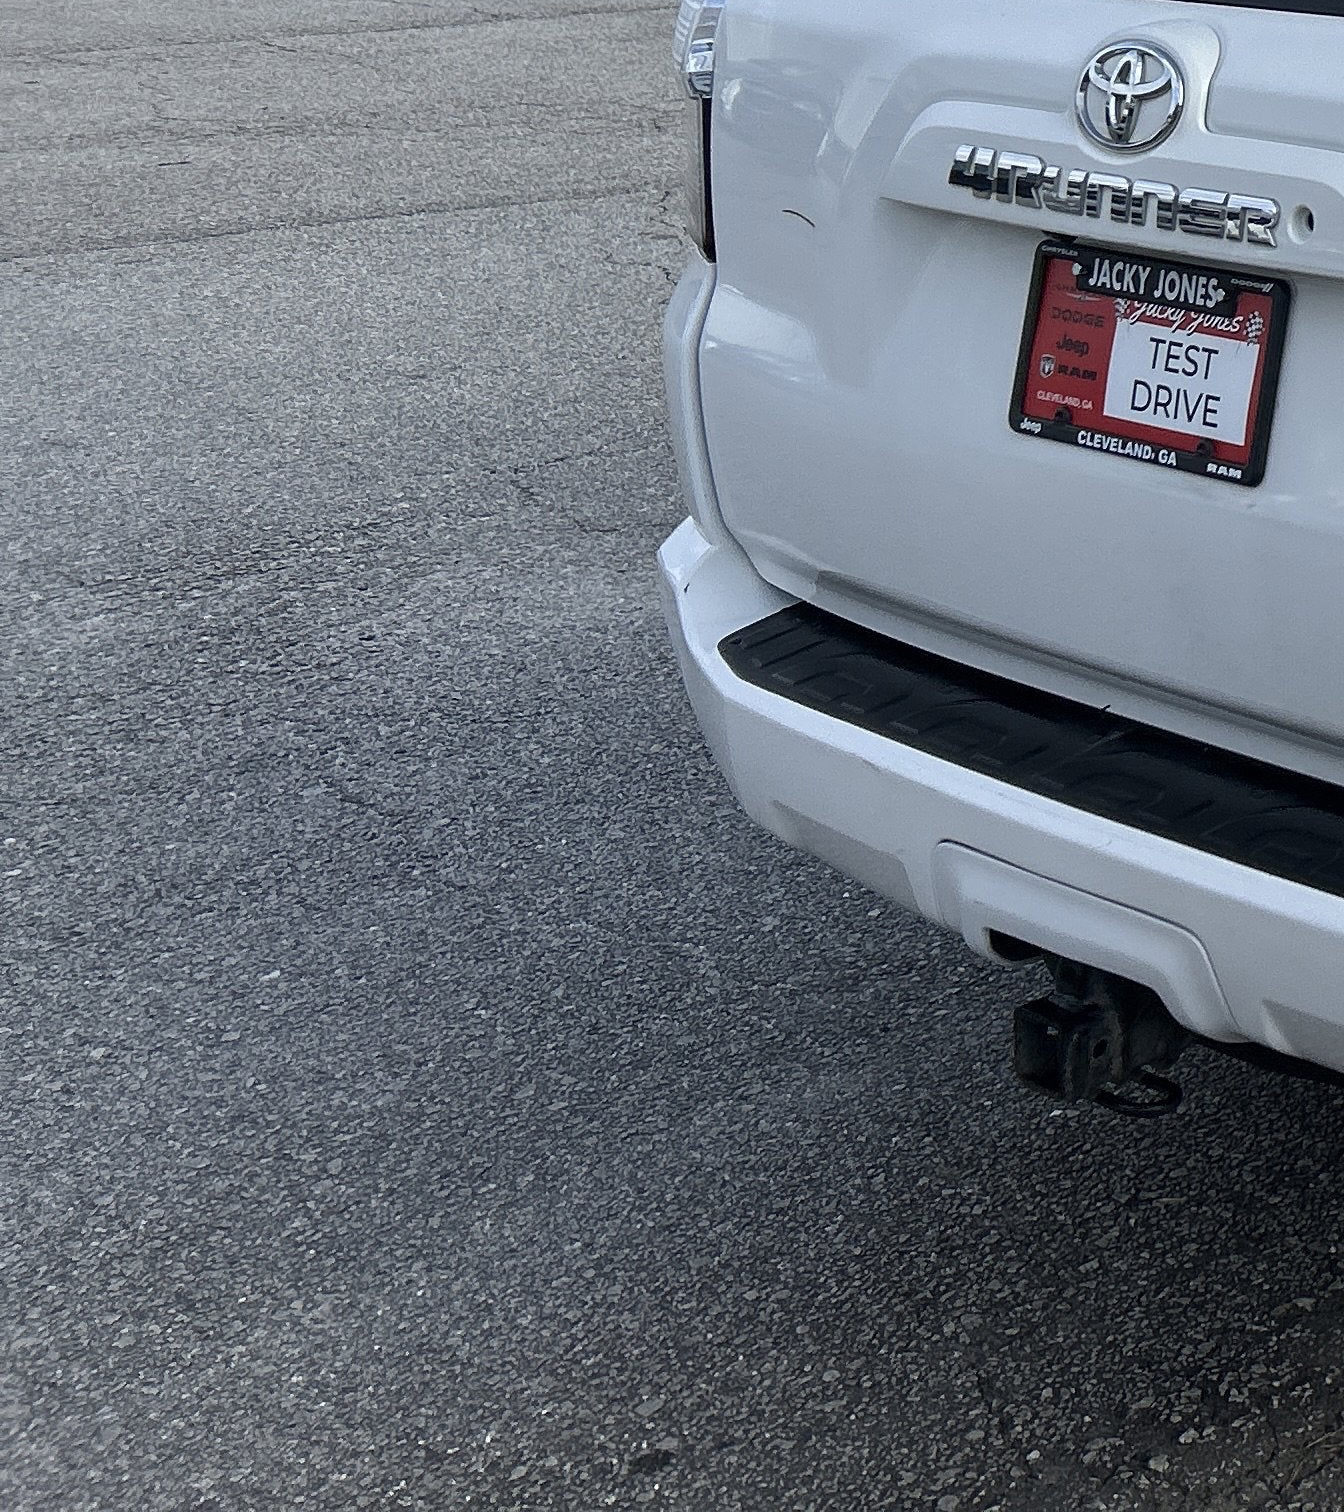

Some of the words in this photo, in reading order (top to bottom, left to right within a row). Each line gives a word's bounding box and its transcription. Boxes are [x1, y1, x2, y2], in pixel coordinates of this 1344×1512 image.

[949, 144, 1282, 248] 4RUNNER
[1088, 258, 1151, 295] JACKY
[1153, 272, 1219, 309] JONES
[1051, 306, 1105, 328] DODGE
[1056, 334, 1090, 357] Jeep
[1150, 336, 1219, 380] TEST
[1057, 364, 1098, 381] RAM
[1130, 379, 1222, 428] DRIVE
[1019, 417, 1042, 434] Jeep
[1077, 430, 1155, 461] CLEVELAND,
[1158, 449, 1177, 467] GA
[1206, 462, 1243, 480] RAM
